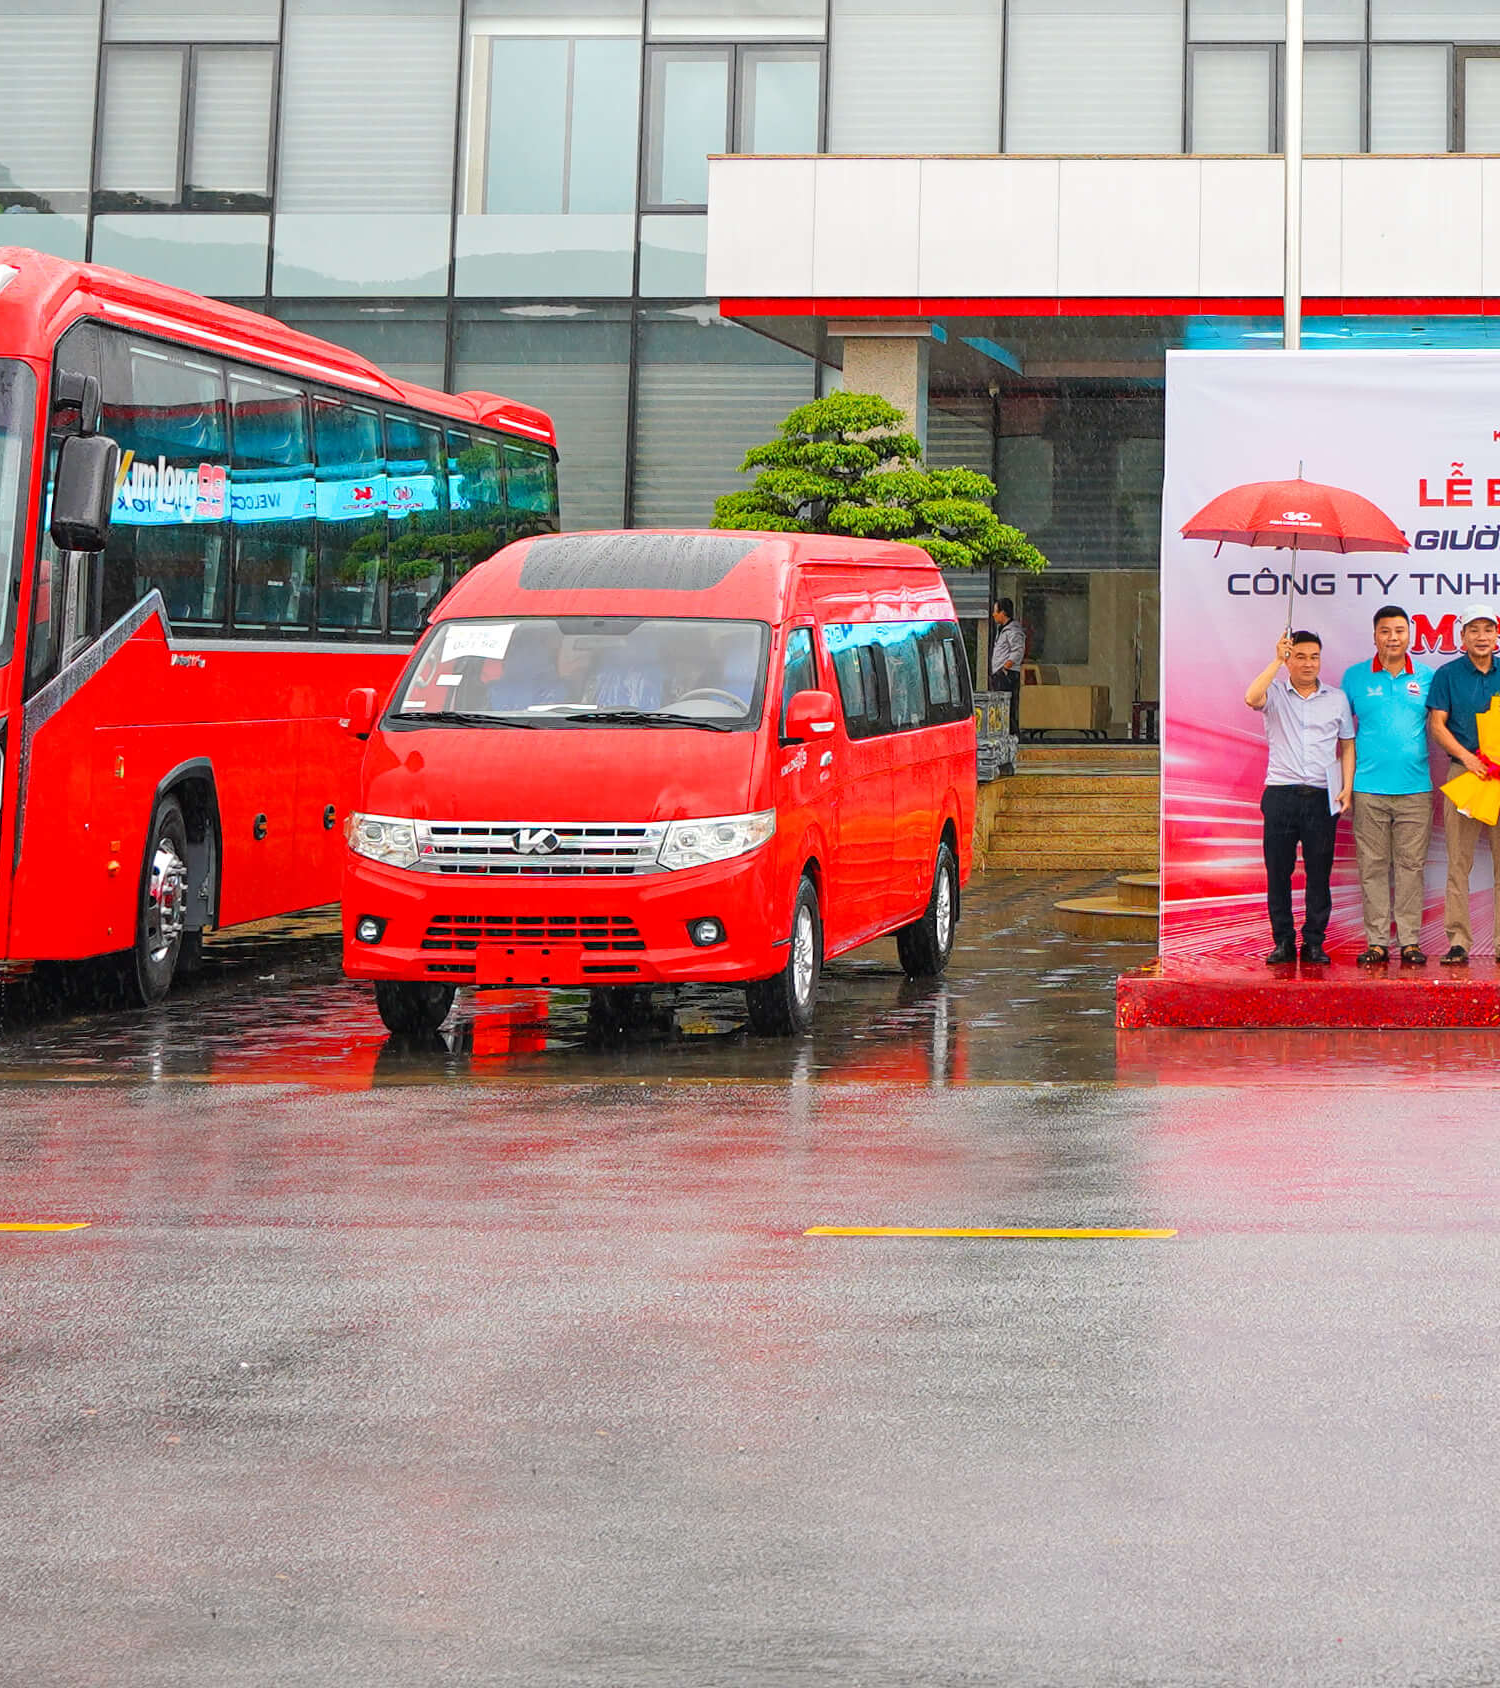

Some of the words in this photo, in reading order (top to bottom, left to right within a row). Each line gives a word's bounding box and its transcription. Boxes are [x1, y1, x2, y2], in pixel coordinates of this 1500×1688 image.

[1419, 462, 1473, 508] LỄ
[1227, 568, 1336, 596] CÔNG
[1347, 573, 1399, 595] TY
